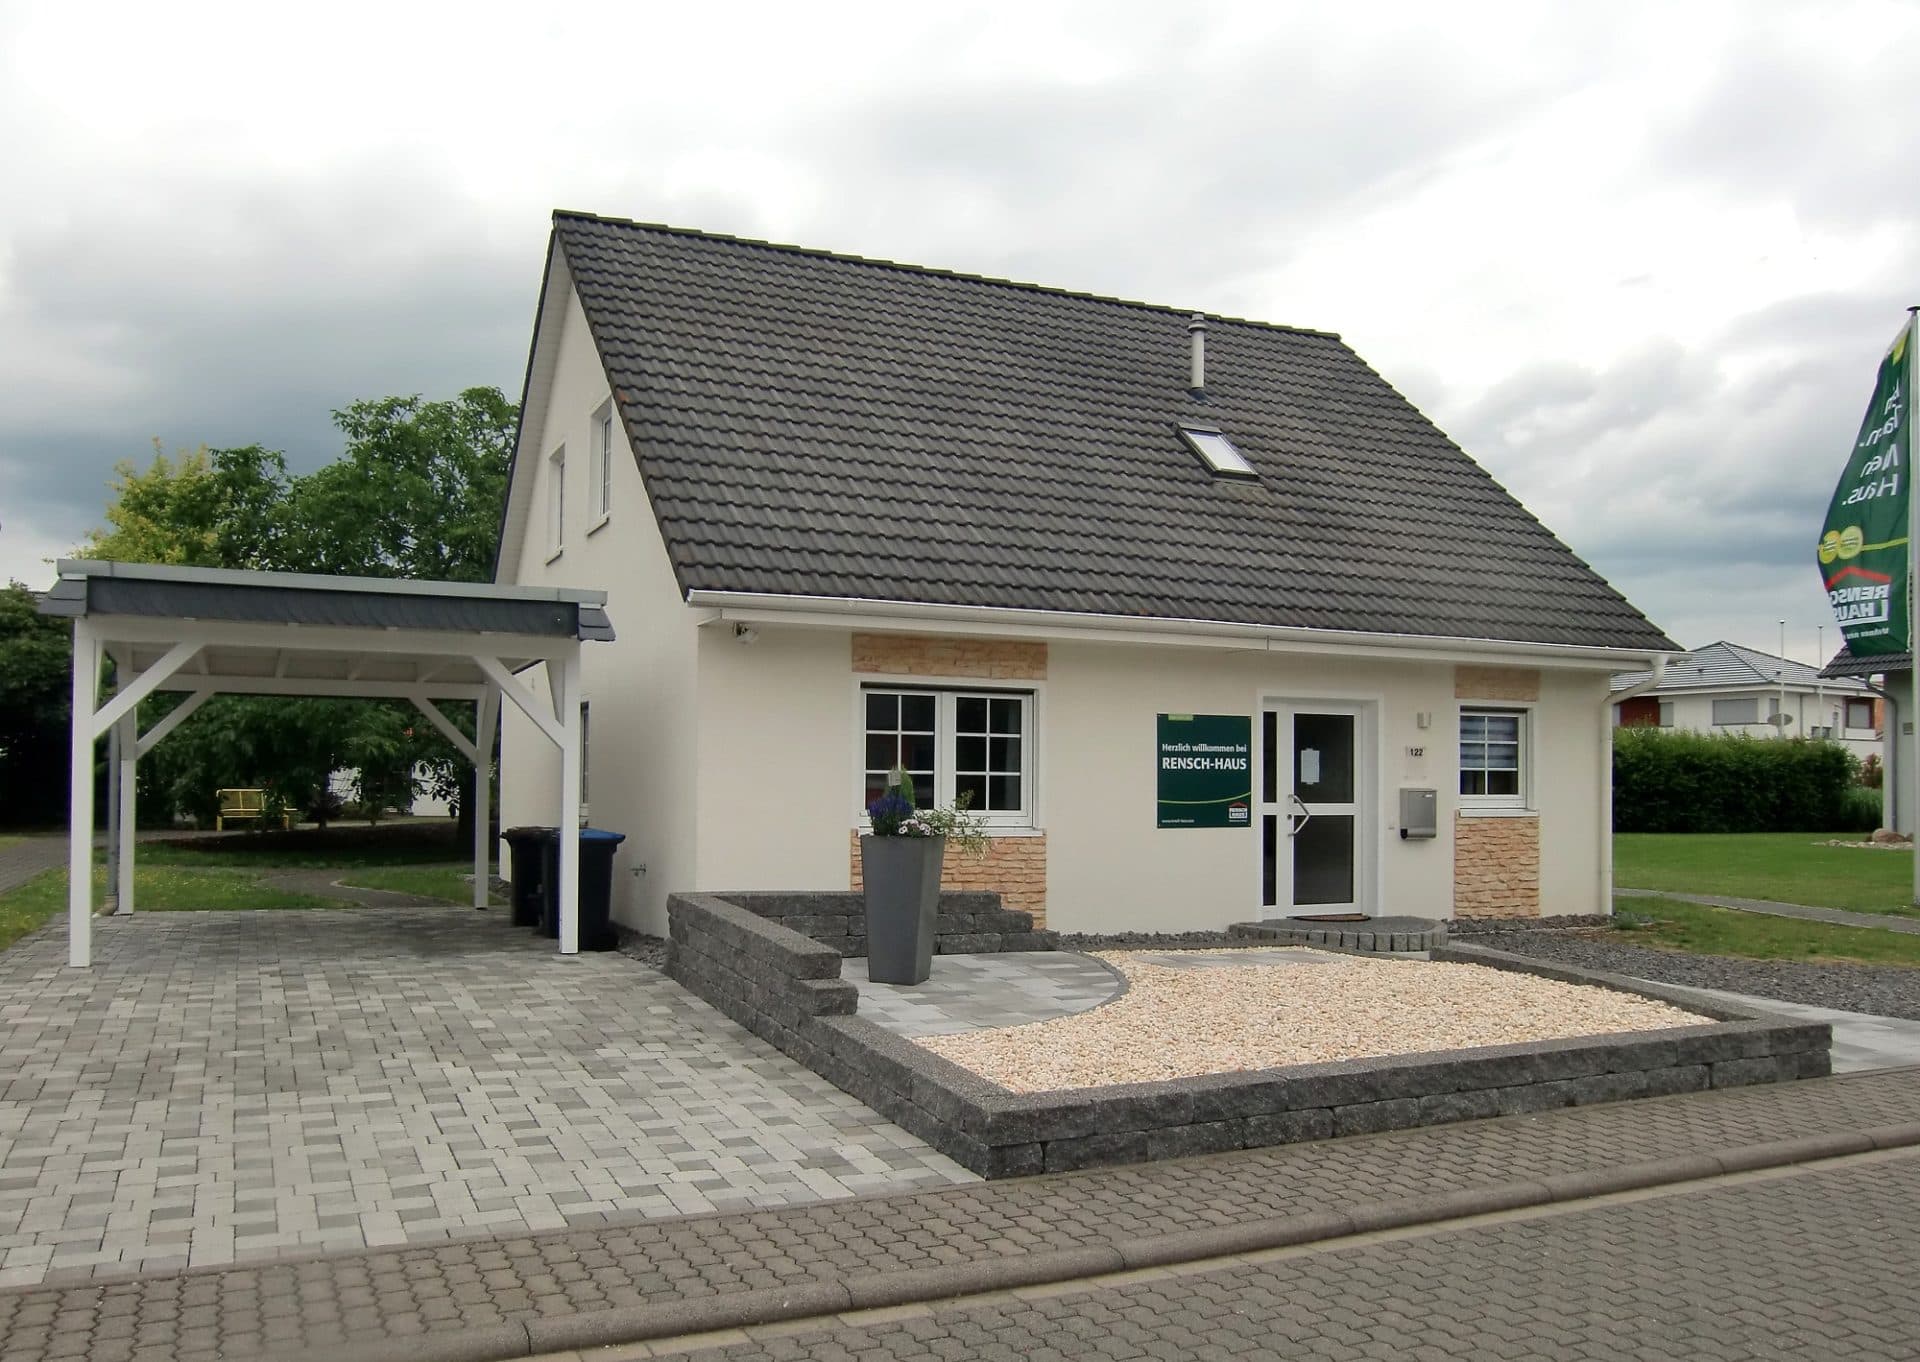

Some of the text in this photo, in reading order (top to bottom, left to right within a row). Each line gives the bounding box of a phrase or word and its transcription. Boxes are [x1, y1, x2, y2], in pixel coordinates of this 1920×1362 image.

[1162, 743, 1247, 753] Herzlich willkommen bei
[1162, 757, 1247, 770] RENSCH-HAUS
